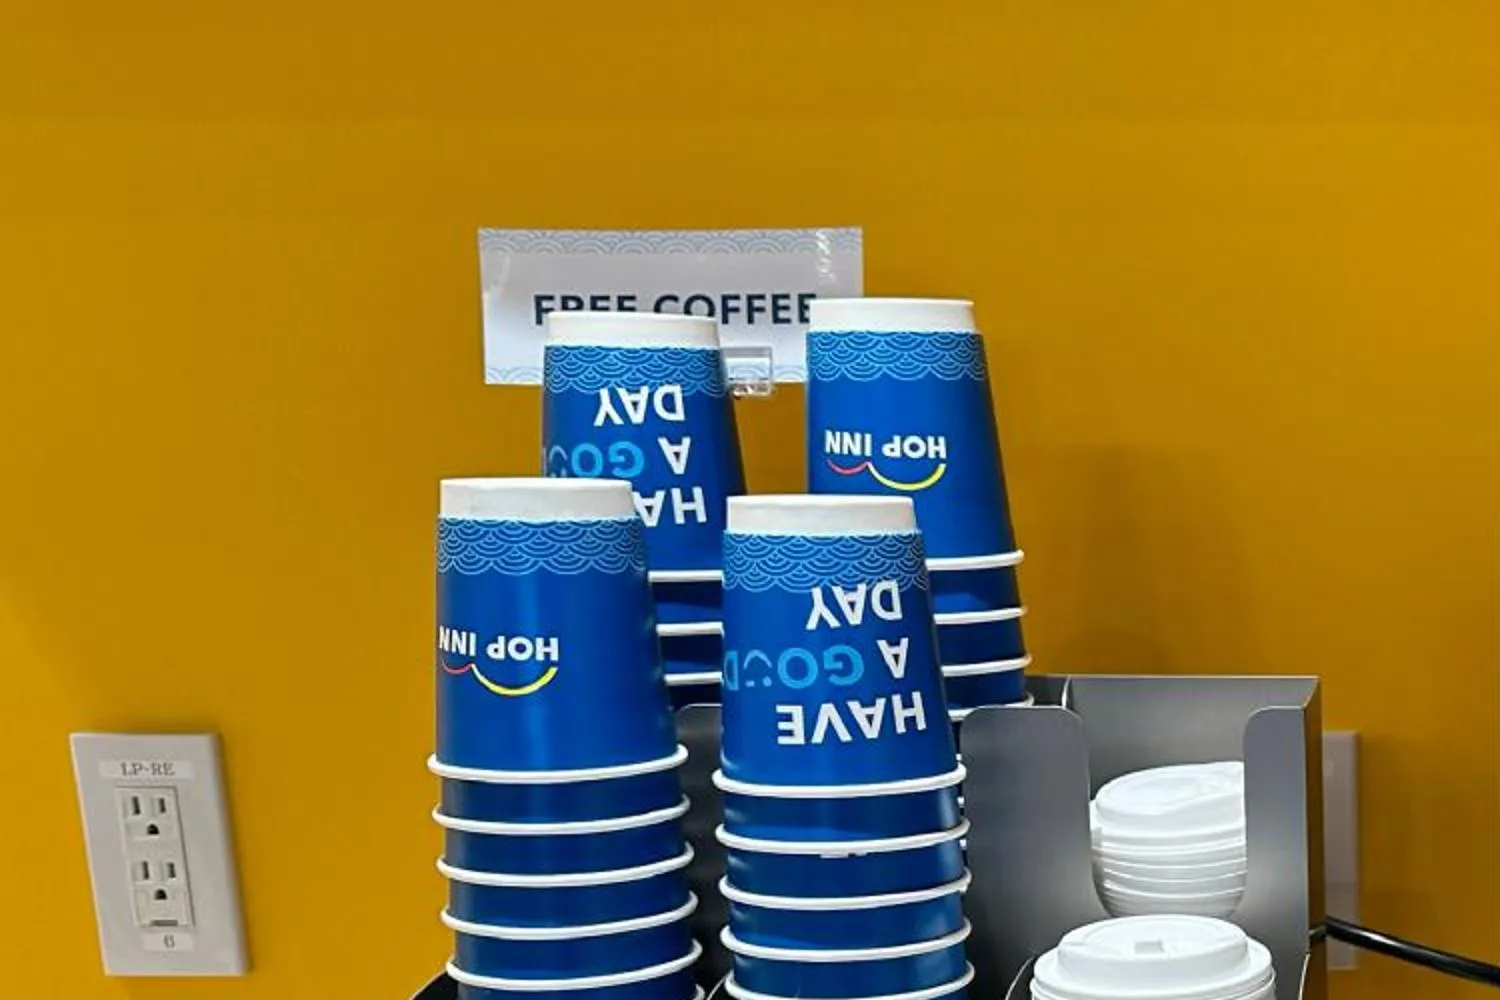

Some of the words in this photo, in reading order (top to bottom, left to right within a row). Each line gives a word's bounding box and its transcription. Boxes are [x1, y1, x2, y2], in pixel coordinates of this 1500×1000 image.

[534, 294, 637, 325] FREE
[653, 293, 817, 325] COFFEE
[593, 384, 686, 427] DAY
[657, 437, 691, 475] A
[825, 429, 872, 457] INN
[881, 435, 947, 459] HOP
[632, 486, 708, 527] HA
[805, 579, 903, 630] DAY
[439, 625, 477, 657] INN
[486, 635, 559, 661] HOP
[876, 637, 909, 679] A
[776, 691, 927, 745] HAVE
